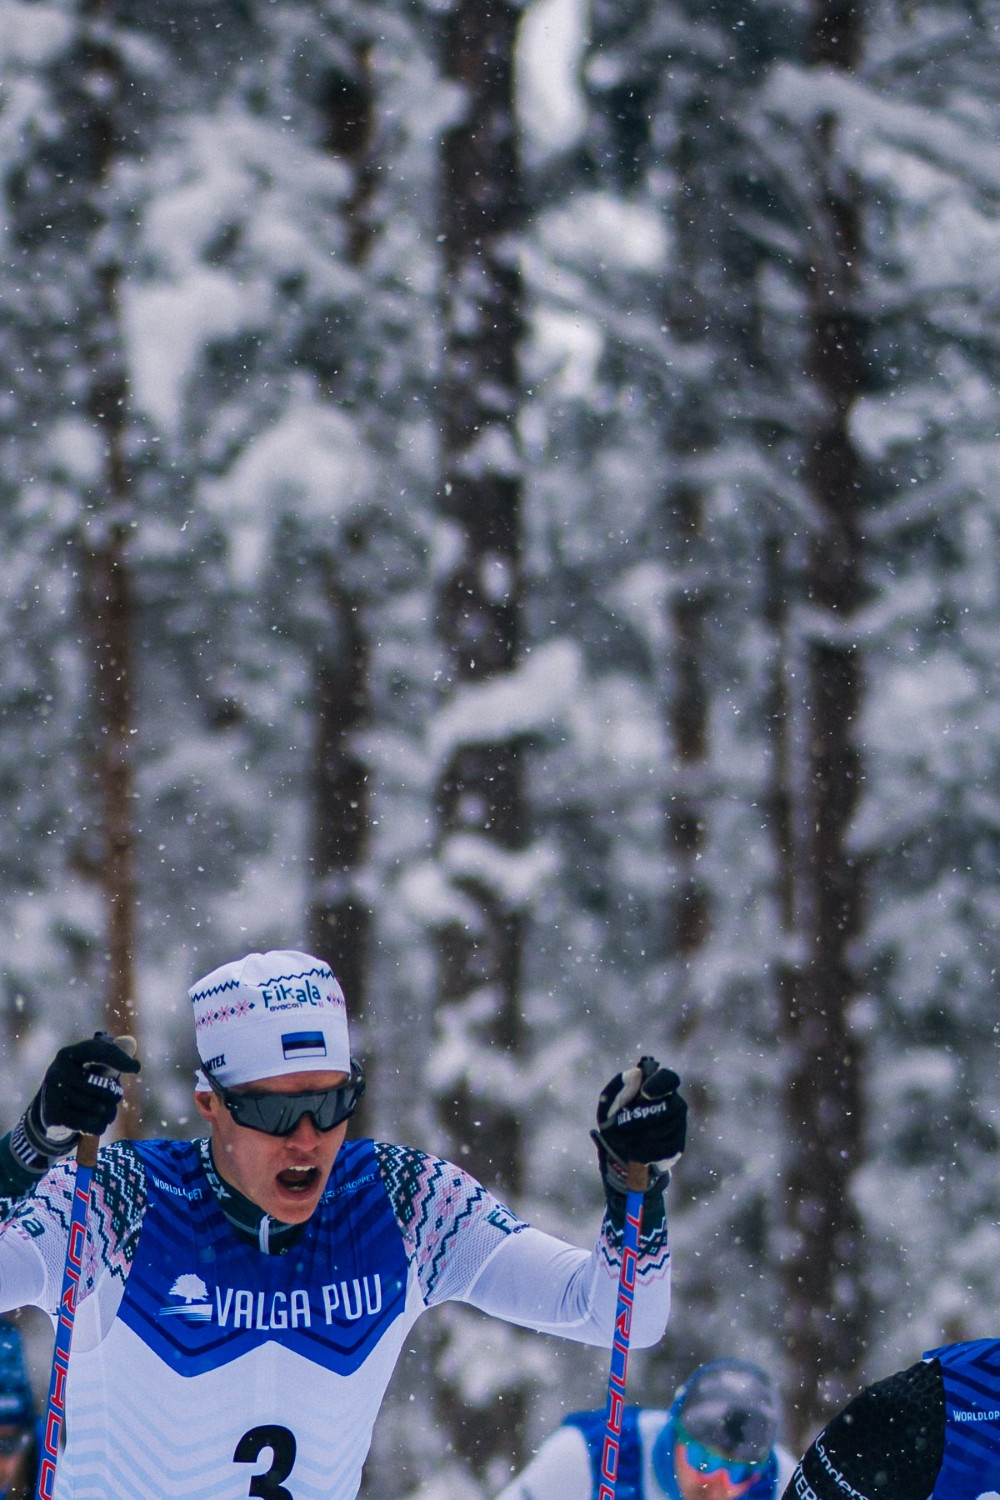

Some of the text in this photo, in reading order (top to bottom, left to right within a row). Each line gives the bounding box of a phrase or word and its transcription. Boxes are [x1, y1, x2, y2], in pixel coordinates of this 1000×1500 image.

[262, 979, 321, 1008] Fikala
[215, 1274, 382, 1330] VALGA PUU
